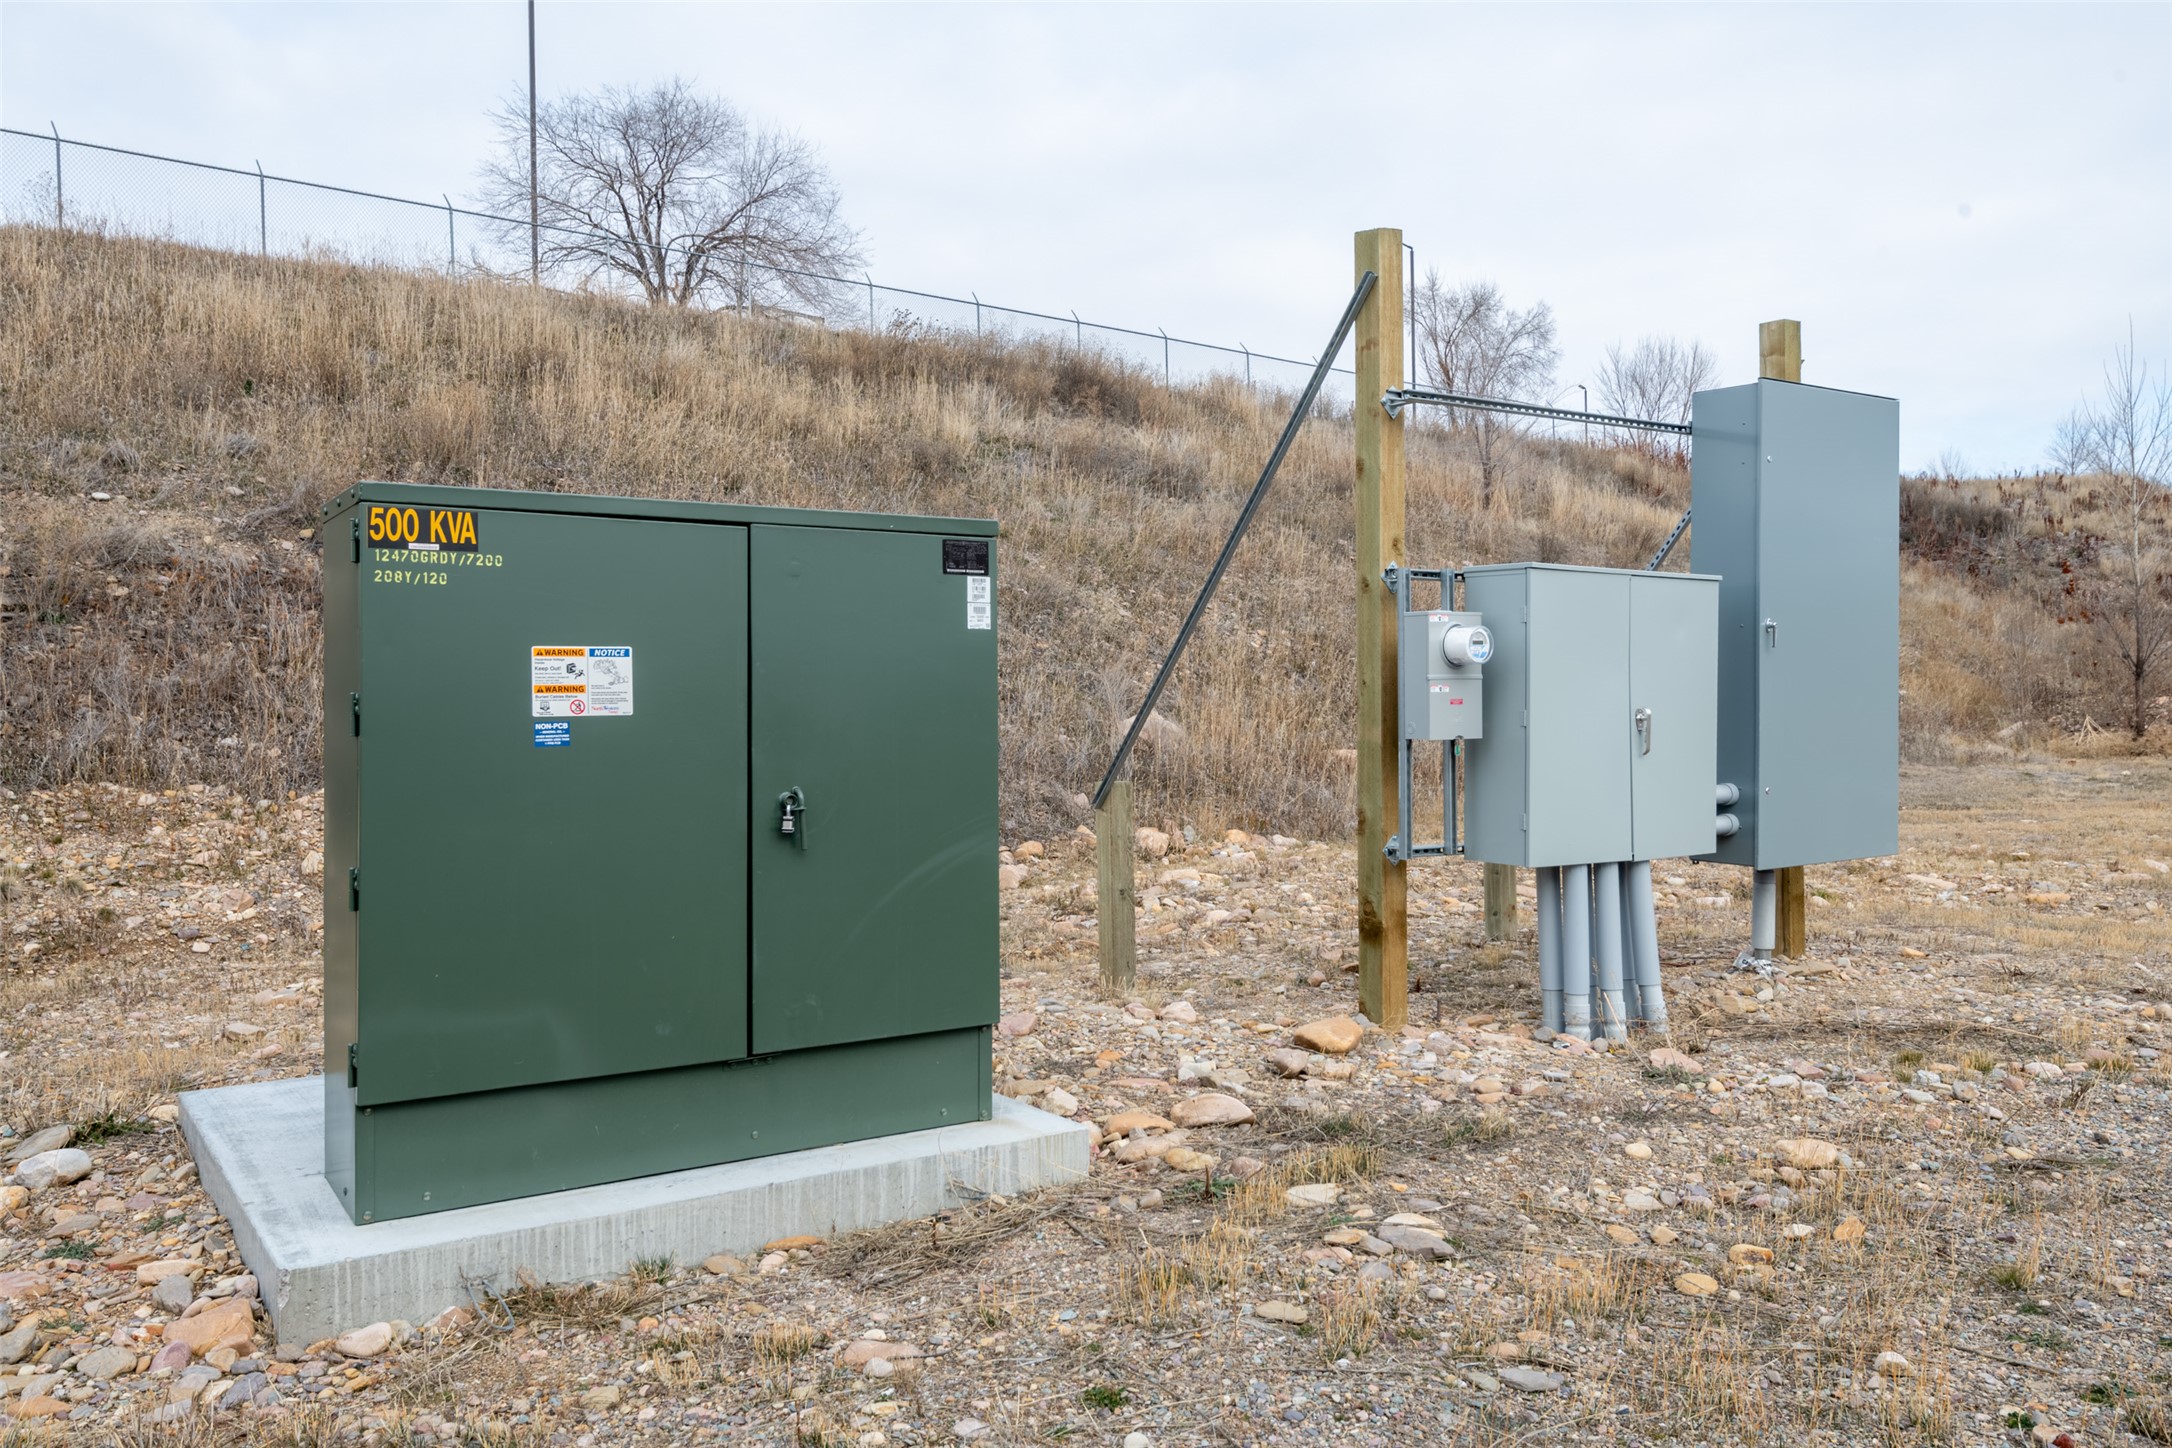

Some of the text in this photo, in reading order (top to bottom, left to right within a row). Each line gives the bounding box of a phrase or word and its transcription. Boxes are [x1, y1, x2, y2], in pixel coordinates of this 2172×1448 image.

[369, 507, 477, 545] 500 KVA
[374, 549, 503, 567] 12470GRDY/7200
[374, 569, 448, 585] 208Y/120
[594, 649, 625, 657] NOTICE
